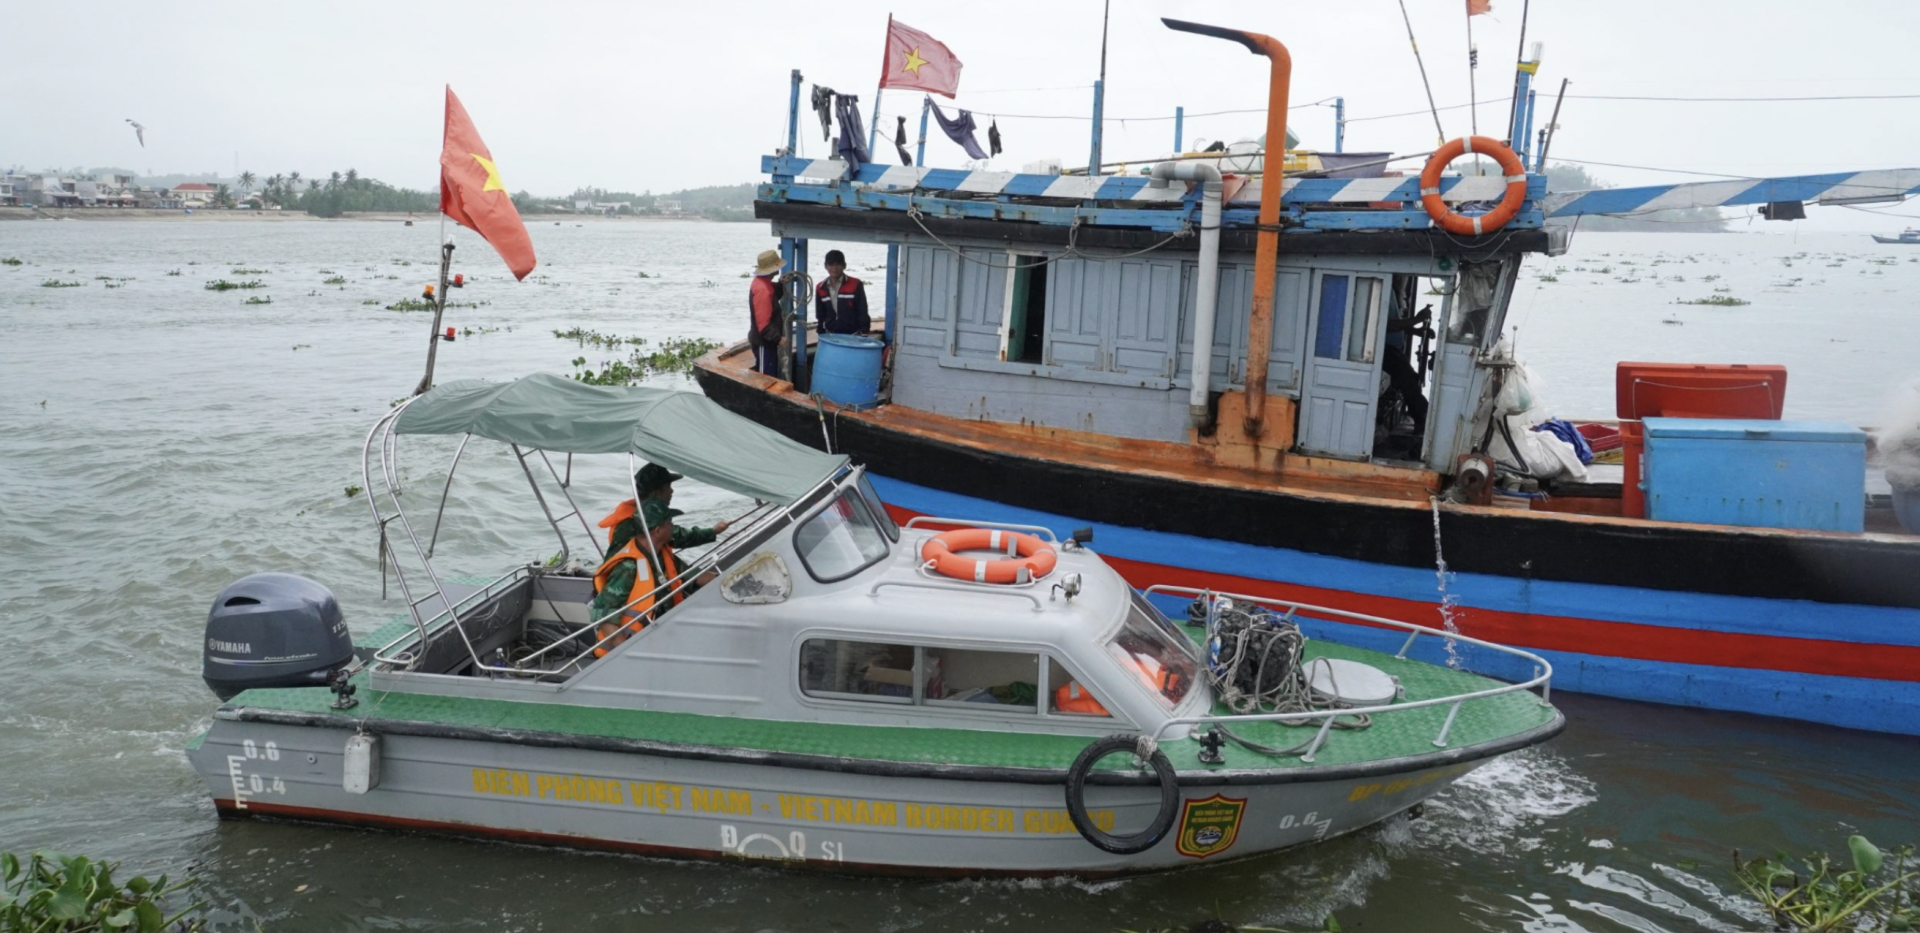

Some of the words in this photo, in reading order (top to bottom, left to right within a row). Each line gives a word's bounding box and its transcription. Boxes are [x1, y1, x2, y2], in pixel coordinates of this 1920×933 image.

[215, 640, 251, 654] YAMAHA
[243, 739, 280, 761] 0.6
[250, 774, 286, 795] 0.4
[472, 767, 531, 797] BIÊN
[537, 772, 624, 805] PHÒNG
[629, 780, 684, 814] VIỆT
[690, 787, 752, 815] NAM
[777, 793, 897, 827] VIETNAM
[905, 803, 1015, 833] BORDER
[1023, 808, 1116, 834] GUAD
[1279, 811, 1318, 829] 0.6
